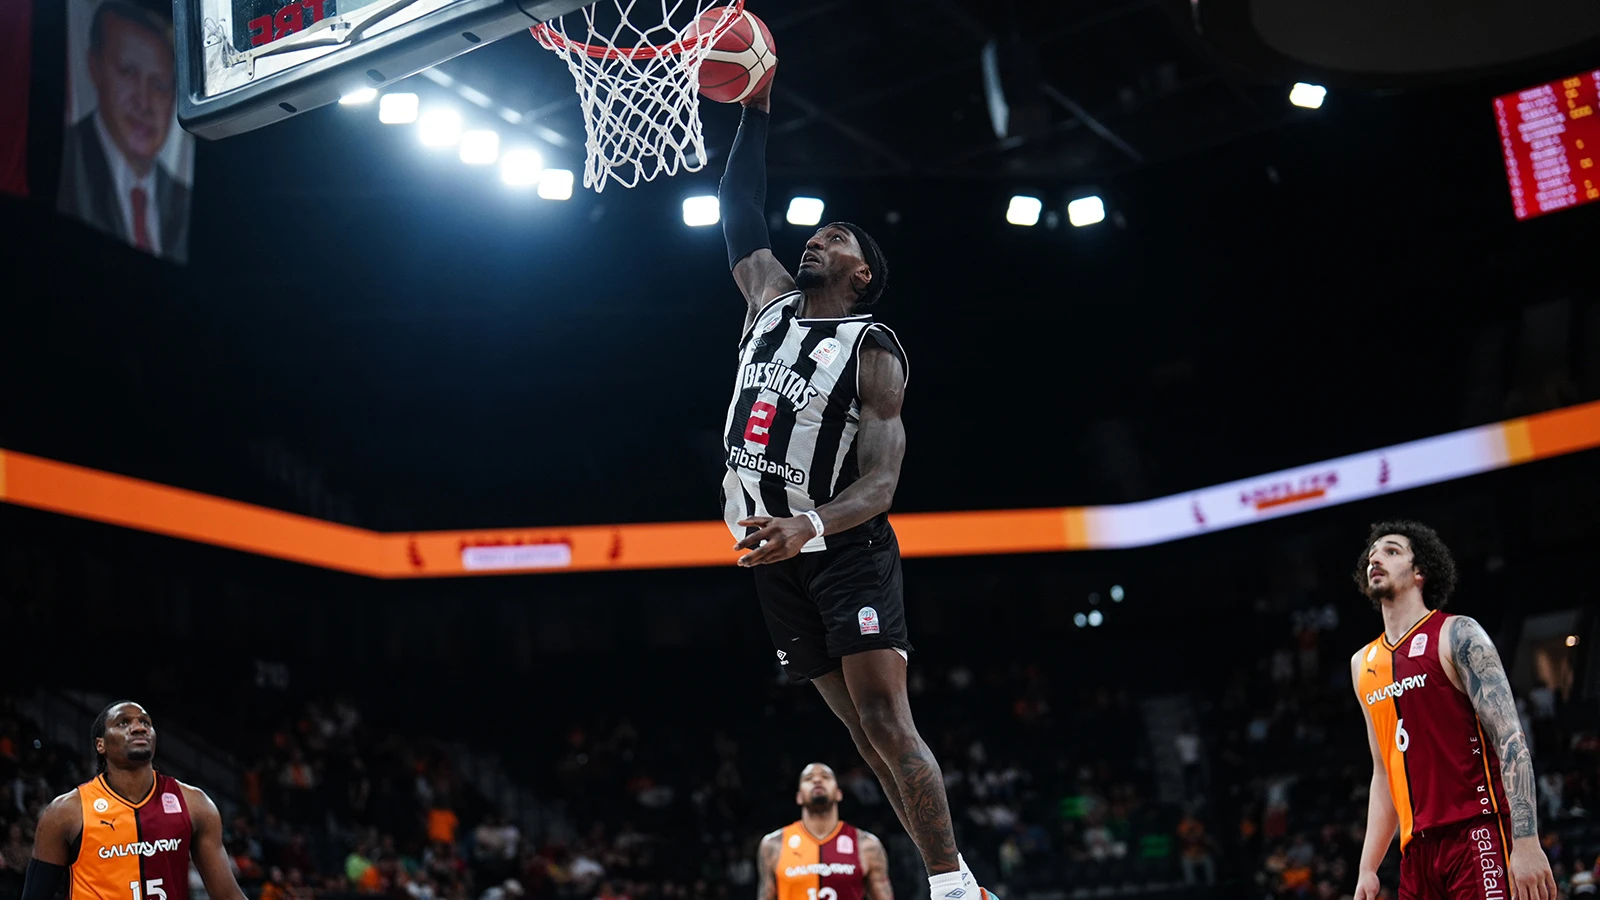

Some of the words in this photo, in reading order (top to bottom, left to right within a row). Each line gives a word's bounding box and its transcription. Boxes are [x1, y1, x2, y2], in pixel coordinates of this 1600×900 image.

[744, 360, 817, 412] BEŞİKTAŞ
[743, 401, 777, 446] 2
[730, 446, 804, 484] Fibabanka
[1366, 674, 1427, 705] GALATASARAY
[1395, 719, 1409, 752] 6
[99, 839, 182, 858] GALATASARAY
